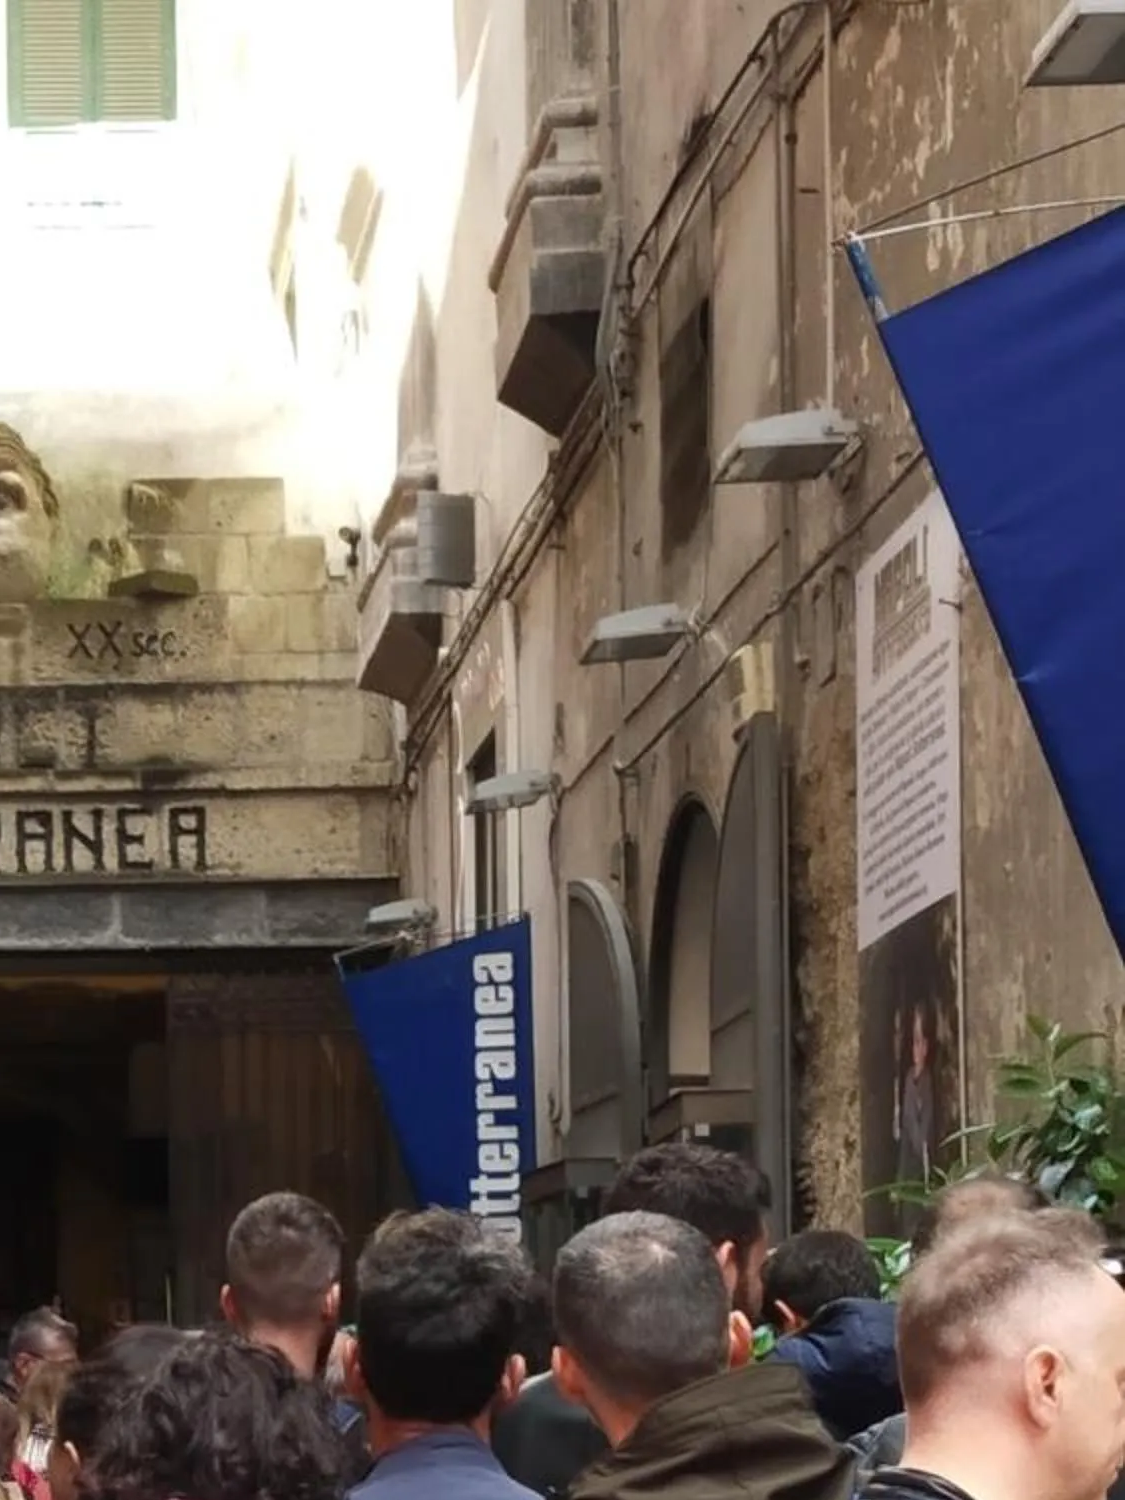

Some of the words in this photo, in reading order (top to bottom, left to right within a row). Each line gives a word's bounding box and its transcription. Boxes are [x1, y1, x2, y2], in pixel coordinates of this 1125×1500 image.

[66, 620, 123, 660] XX
[130, 630, 188, 659] sec.
[469, 952, 522, 1244] otterranea
